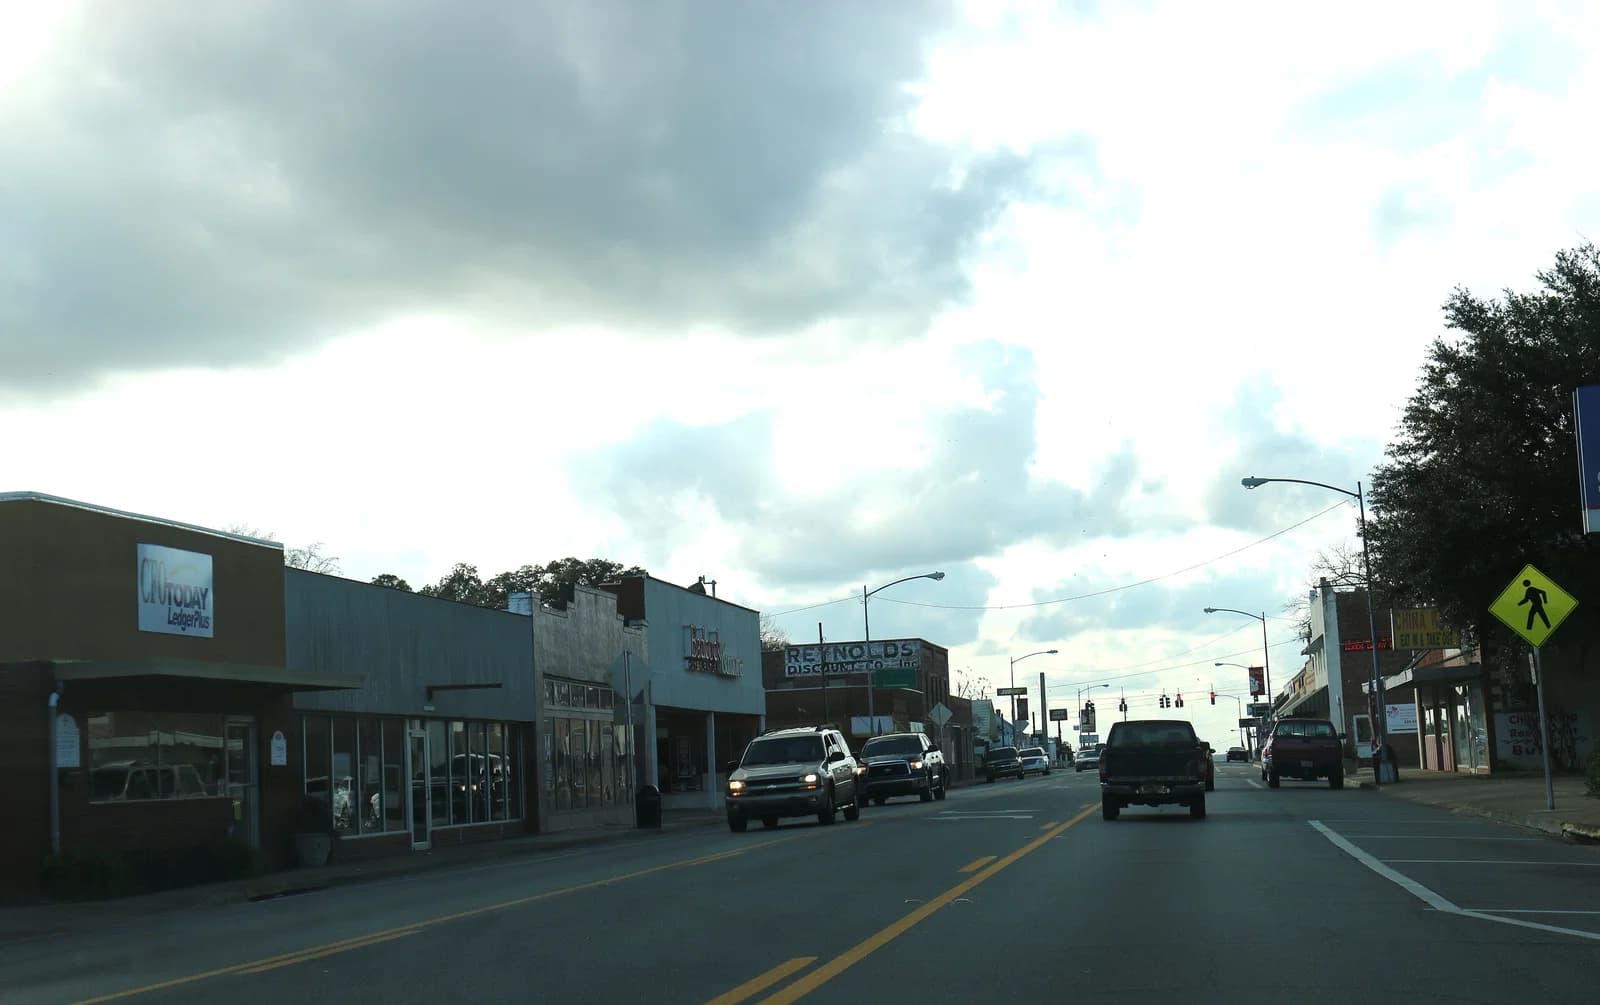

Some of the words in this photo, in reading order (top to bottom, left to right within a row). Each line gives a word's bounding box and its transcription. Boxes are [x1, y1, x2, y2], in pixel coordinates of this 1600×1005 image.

[168, 607, 210, 631] LedgerPlus
[787, 642, 914, 664] REYNOLDS
[787, 662, 855, 675] DISCOUNT
